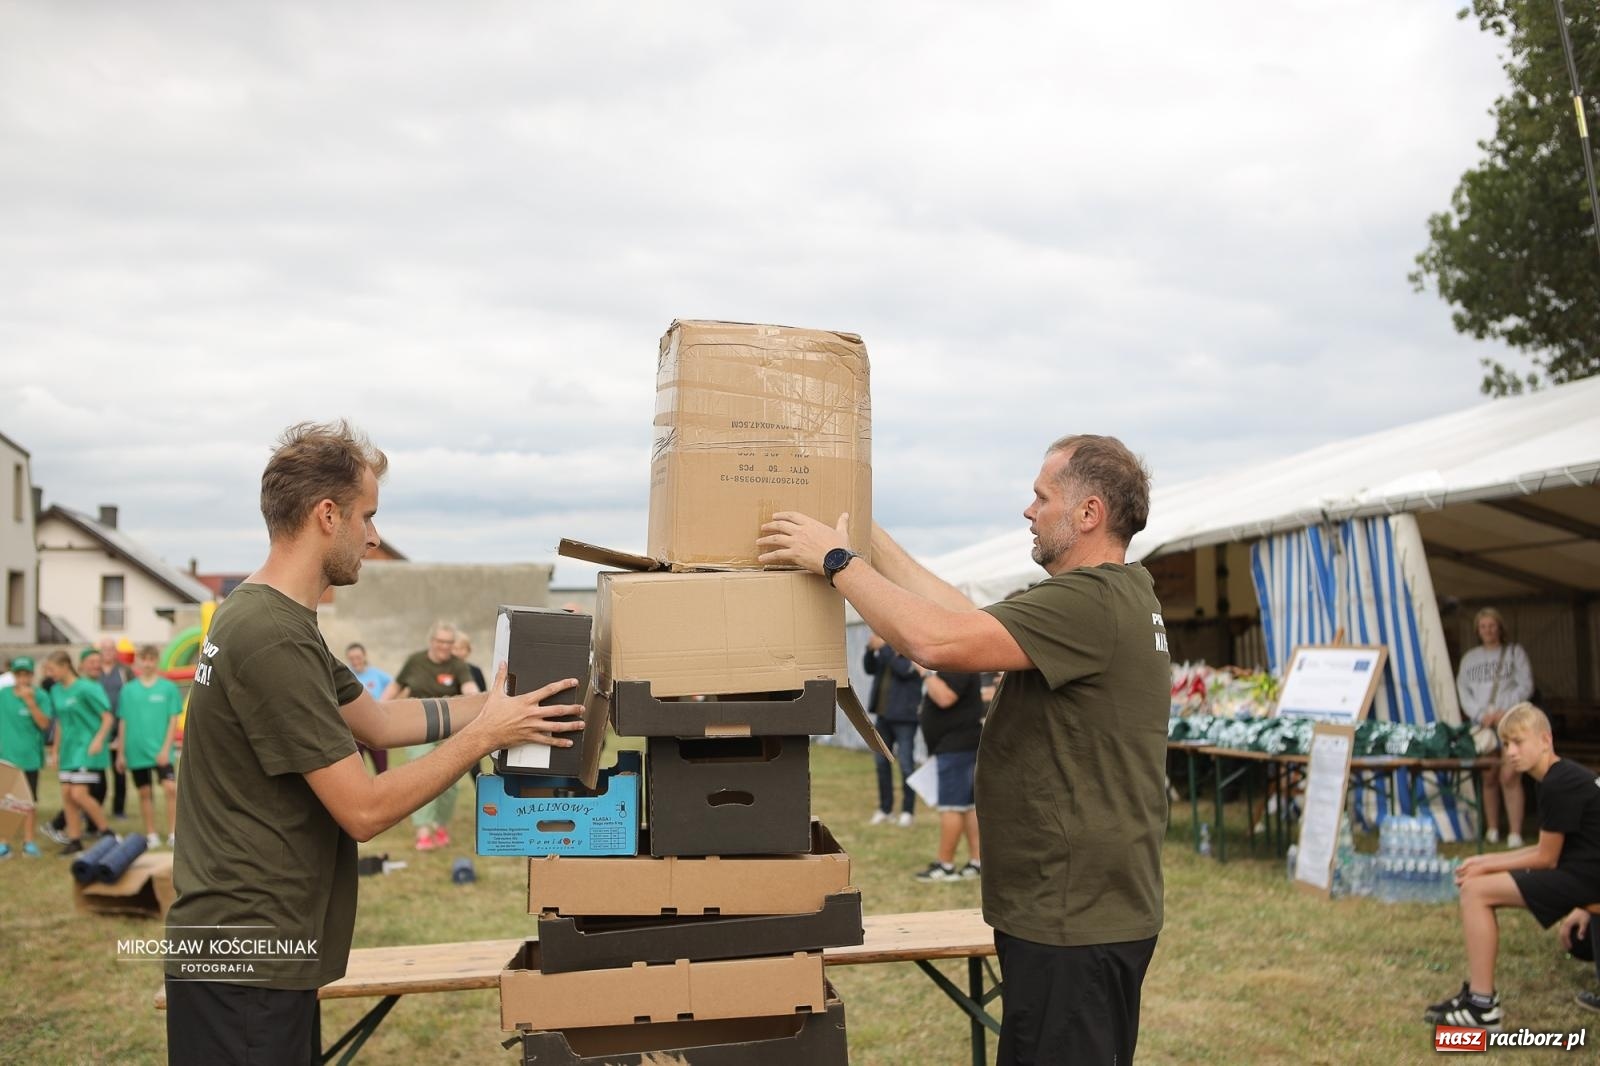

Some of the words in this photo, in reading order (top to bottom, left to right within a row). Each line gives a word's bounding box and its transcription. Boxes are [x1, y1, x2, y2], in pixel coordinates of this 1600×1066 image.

[738, 463, 754, 472] PCS
[768, 464, 779, 473] 50
[790, 465, 810, 474] QTY:
[515, 802, 594, 817] MALINOWY
